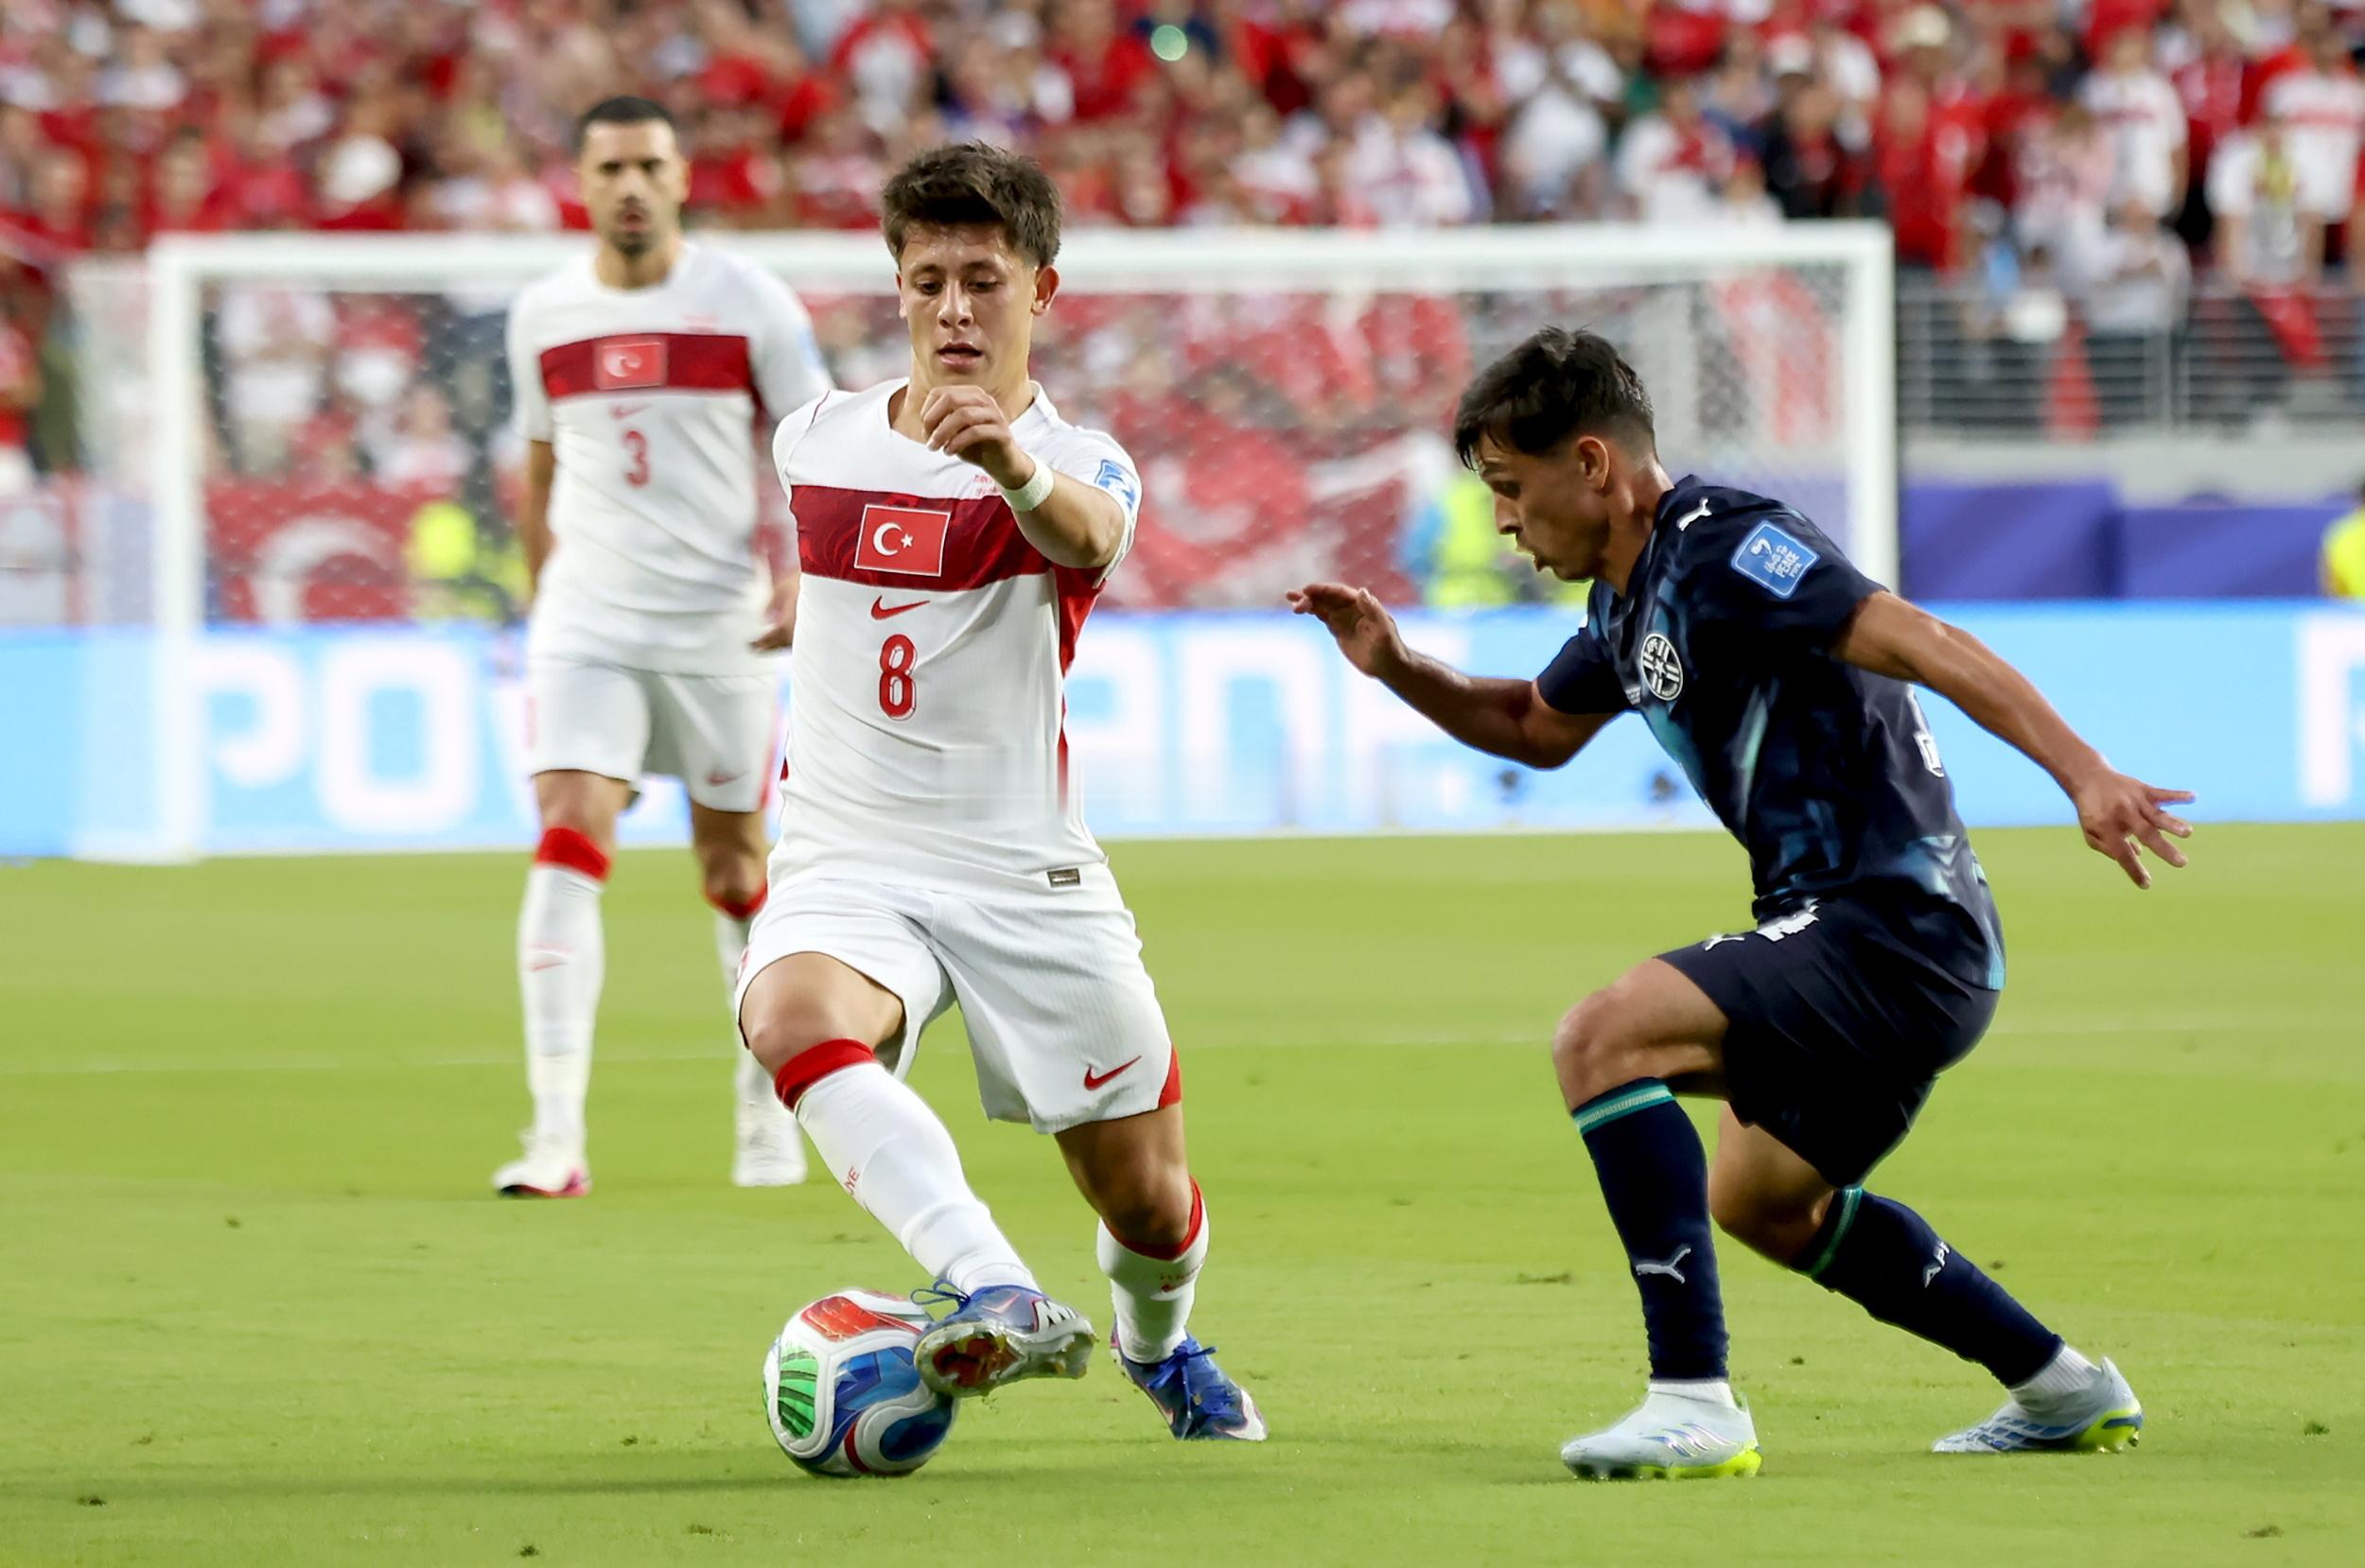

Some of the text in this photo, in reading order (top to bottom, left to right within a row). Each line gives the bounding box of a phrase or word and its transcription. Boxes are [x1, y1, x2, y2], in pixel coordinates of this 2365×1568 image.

[620, 428, 651, 489] 3
[1774, 549, 1800, 579] PEACE
[879, 633, 917, 722] 8
